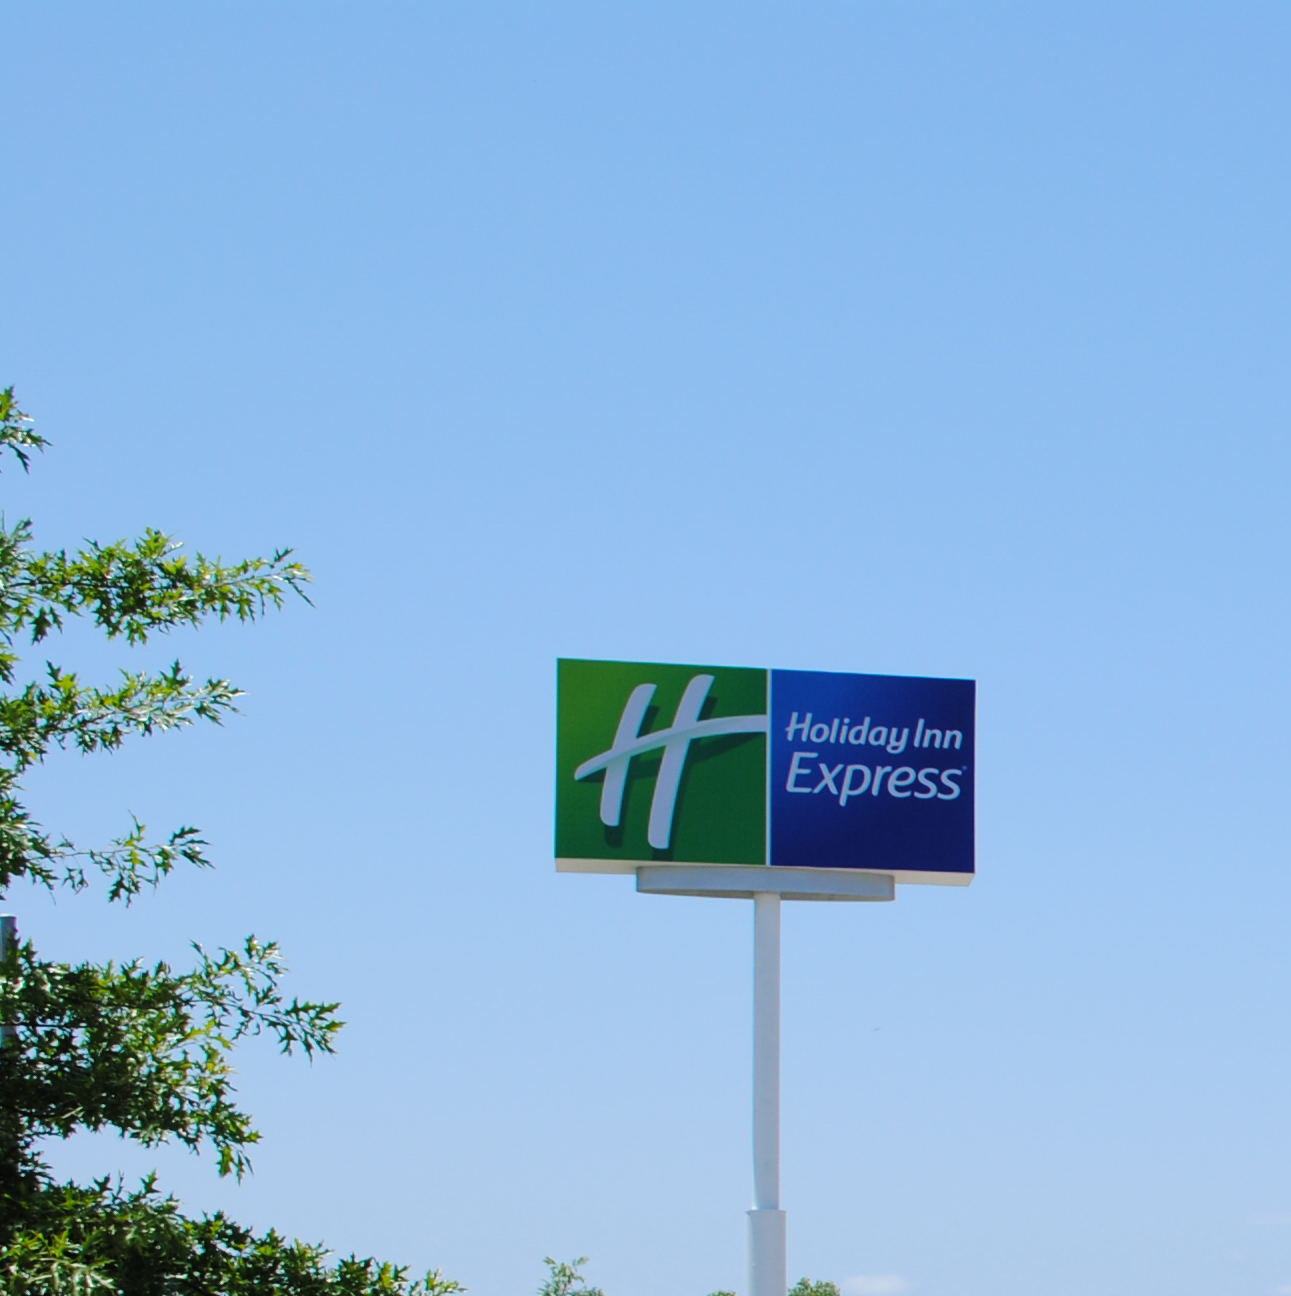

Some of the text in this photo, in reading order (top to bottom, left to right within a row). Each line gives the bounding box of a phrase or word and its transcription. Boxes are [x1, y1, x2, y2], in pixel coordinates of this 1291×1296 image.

[785, 711, 963, 754] Holiday Inn
[785, 751, 963, 807] Express
